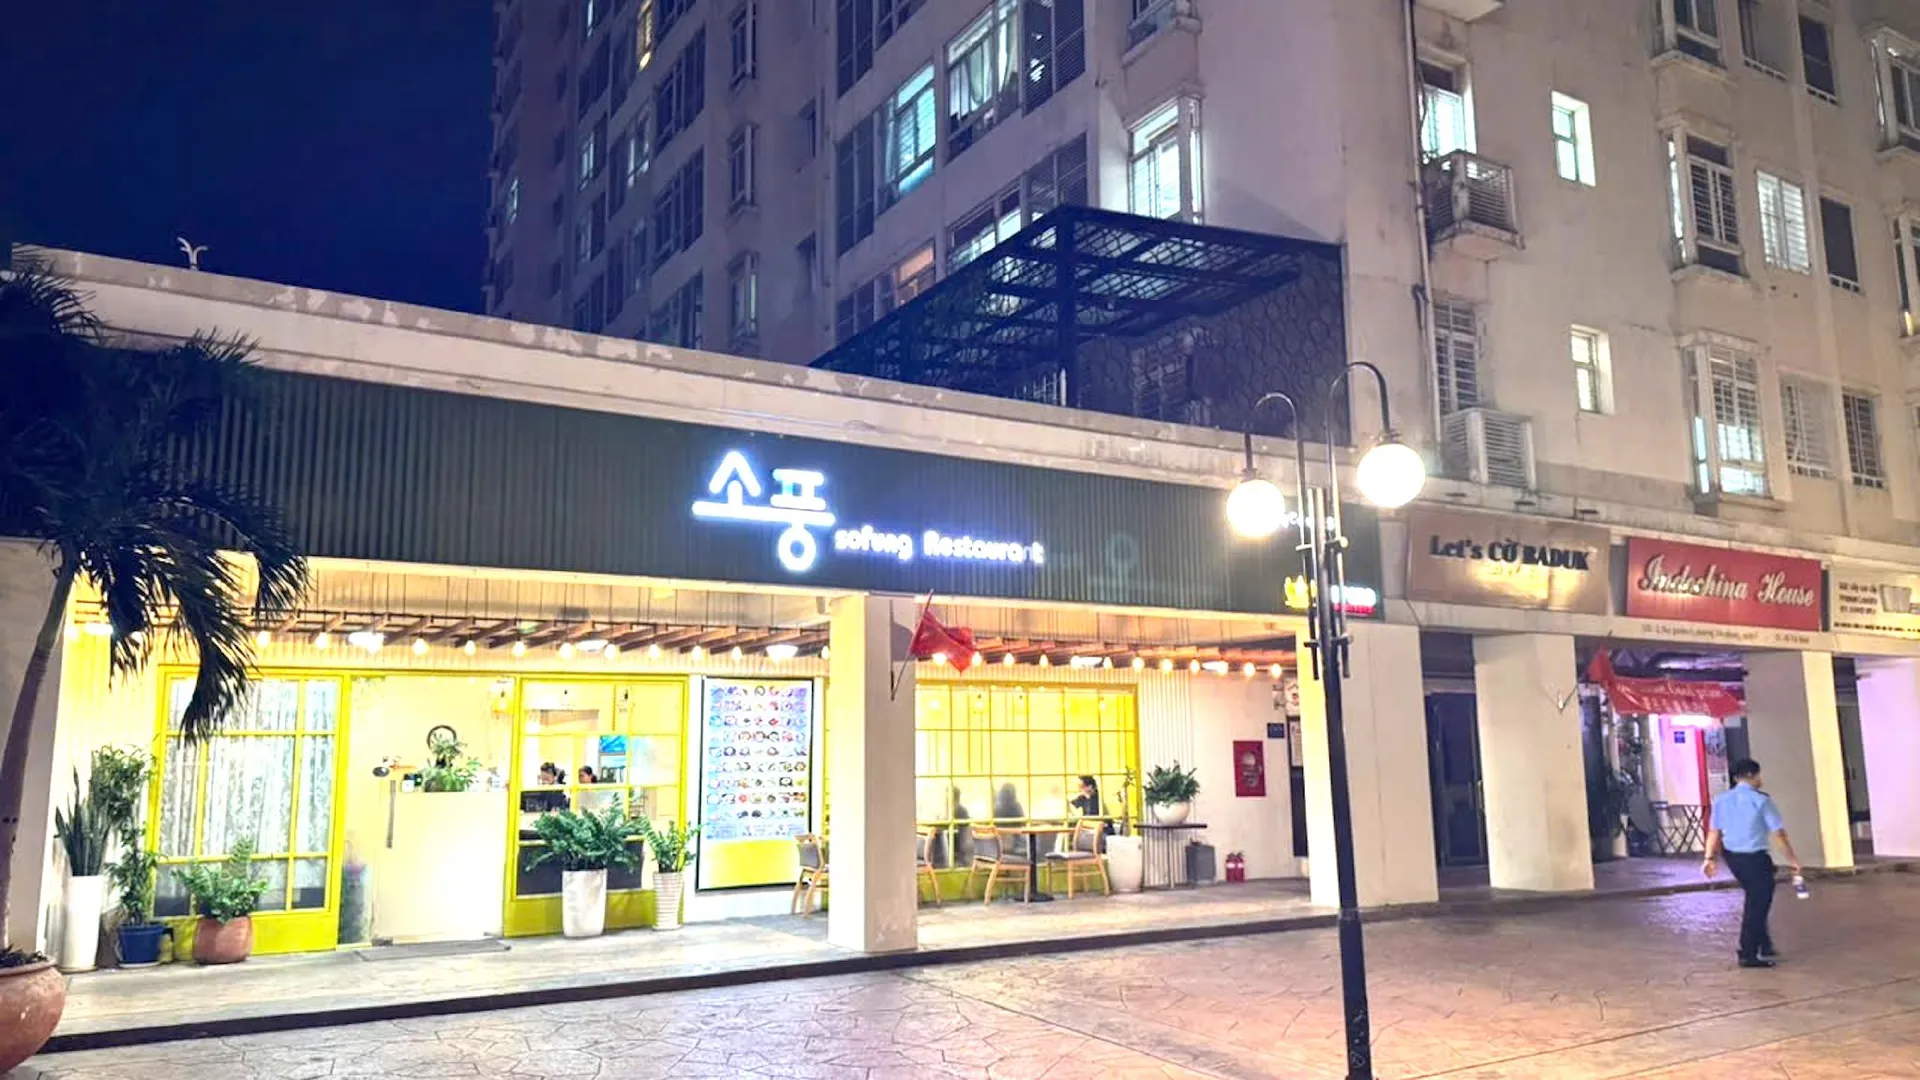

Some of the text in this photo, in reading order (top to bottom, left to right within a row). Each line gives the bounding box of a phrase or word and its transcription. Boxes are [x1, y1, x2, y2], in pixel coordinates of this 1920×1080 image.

[692, 451, 836, 572] 소풍
[835, 525, 912, 560] sofung
[1430, 535, 1483, 560] Let's
[1522, 545, 1589, 570] BADUK
[1638, 553, 1815, 607] Indochina House
